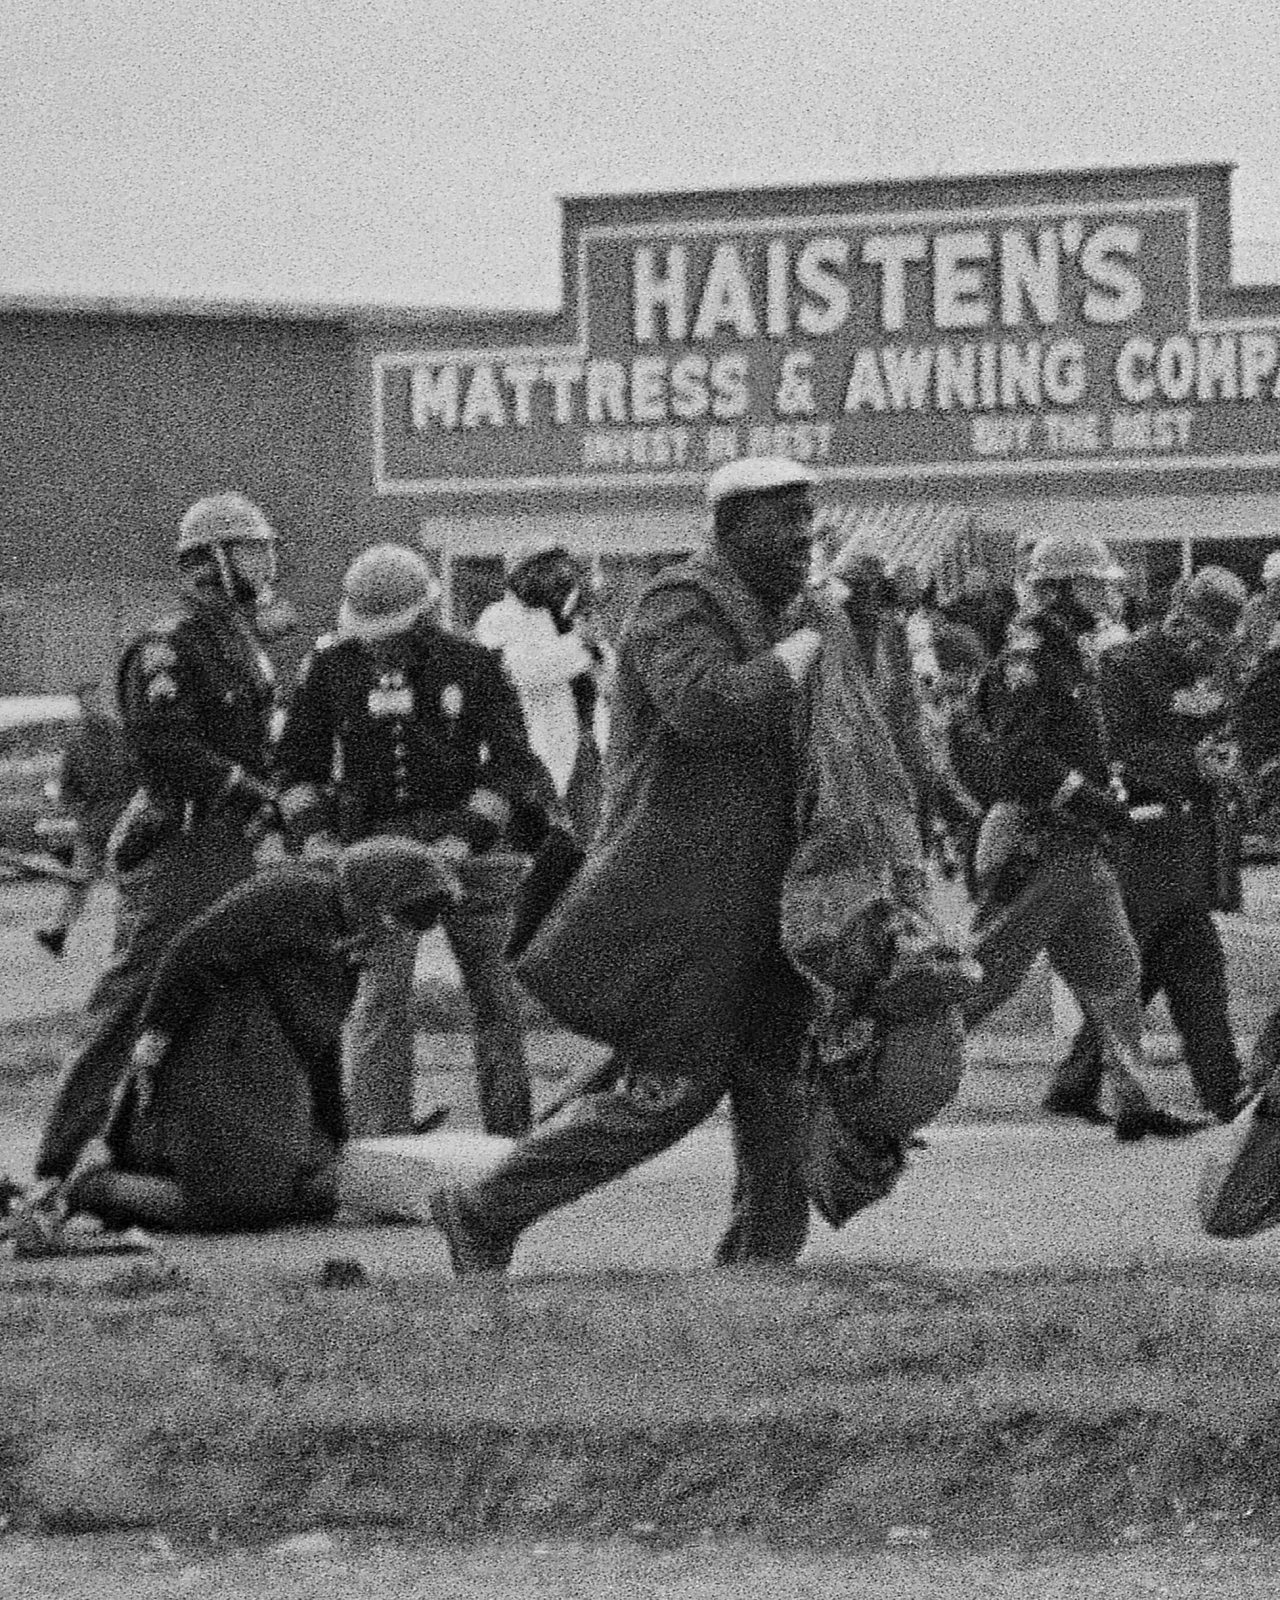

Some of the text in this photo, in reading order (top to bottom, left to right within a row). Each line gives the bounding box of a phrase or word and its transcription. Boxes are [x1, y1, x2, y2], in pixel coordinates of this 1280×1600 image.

[633, 217, 1145, 341] HAISTEN'S
[411, 353, 749, 428] MATTRESS
[777, 350, 815, 413] &
[843, 337, 1086, 411] AWNING
